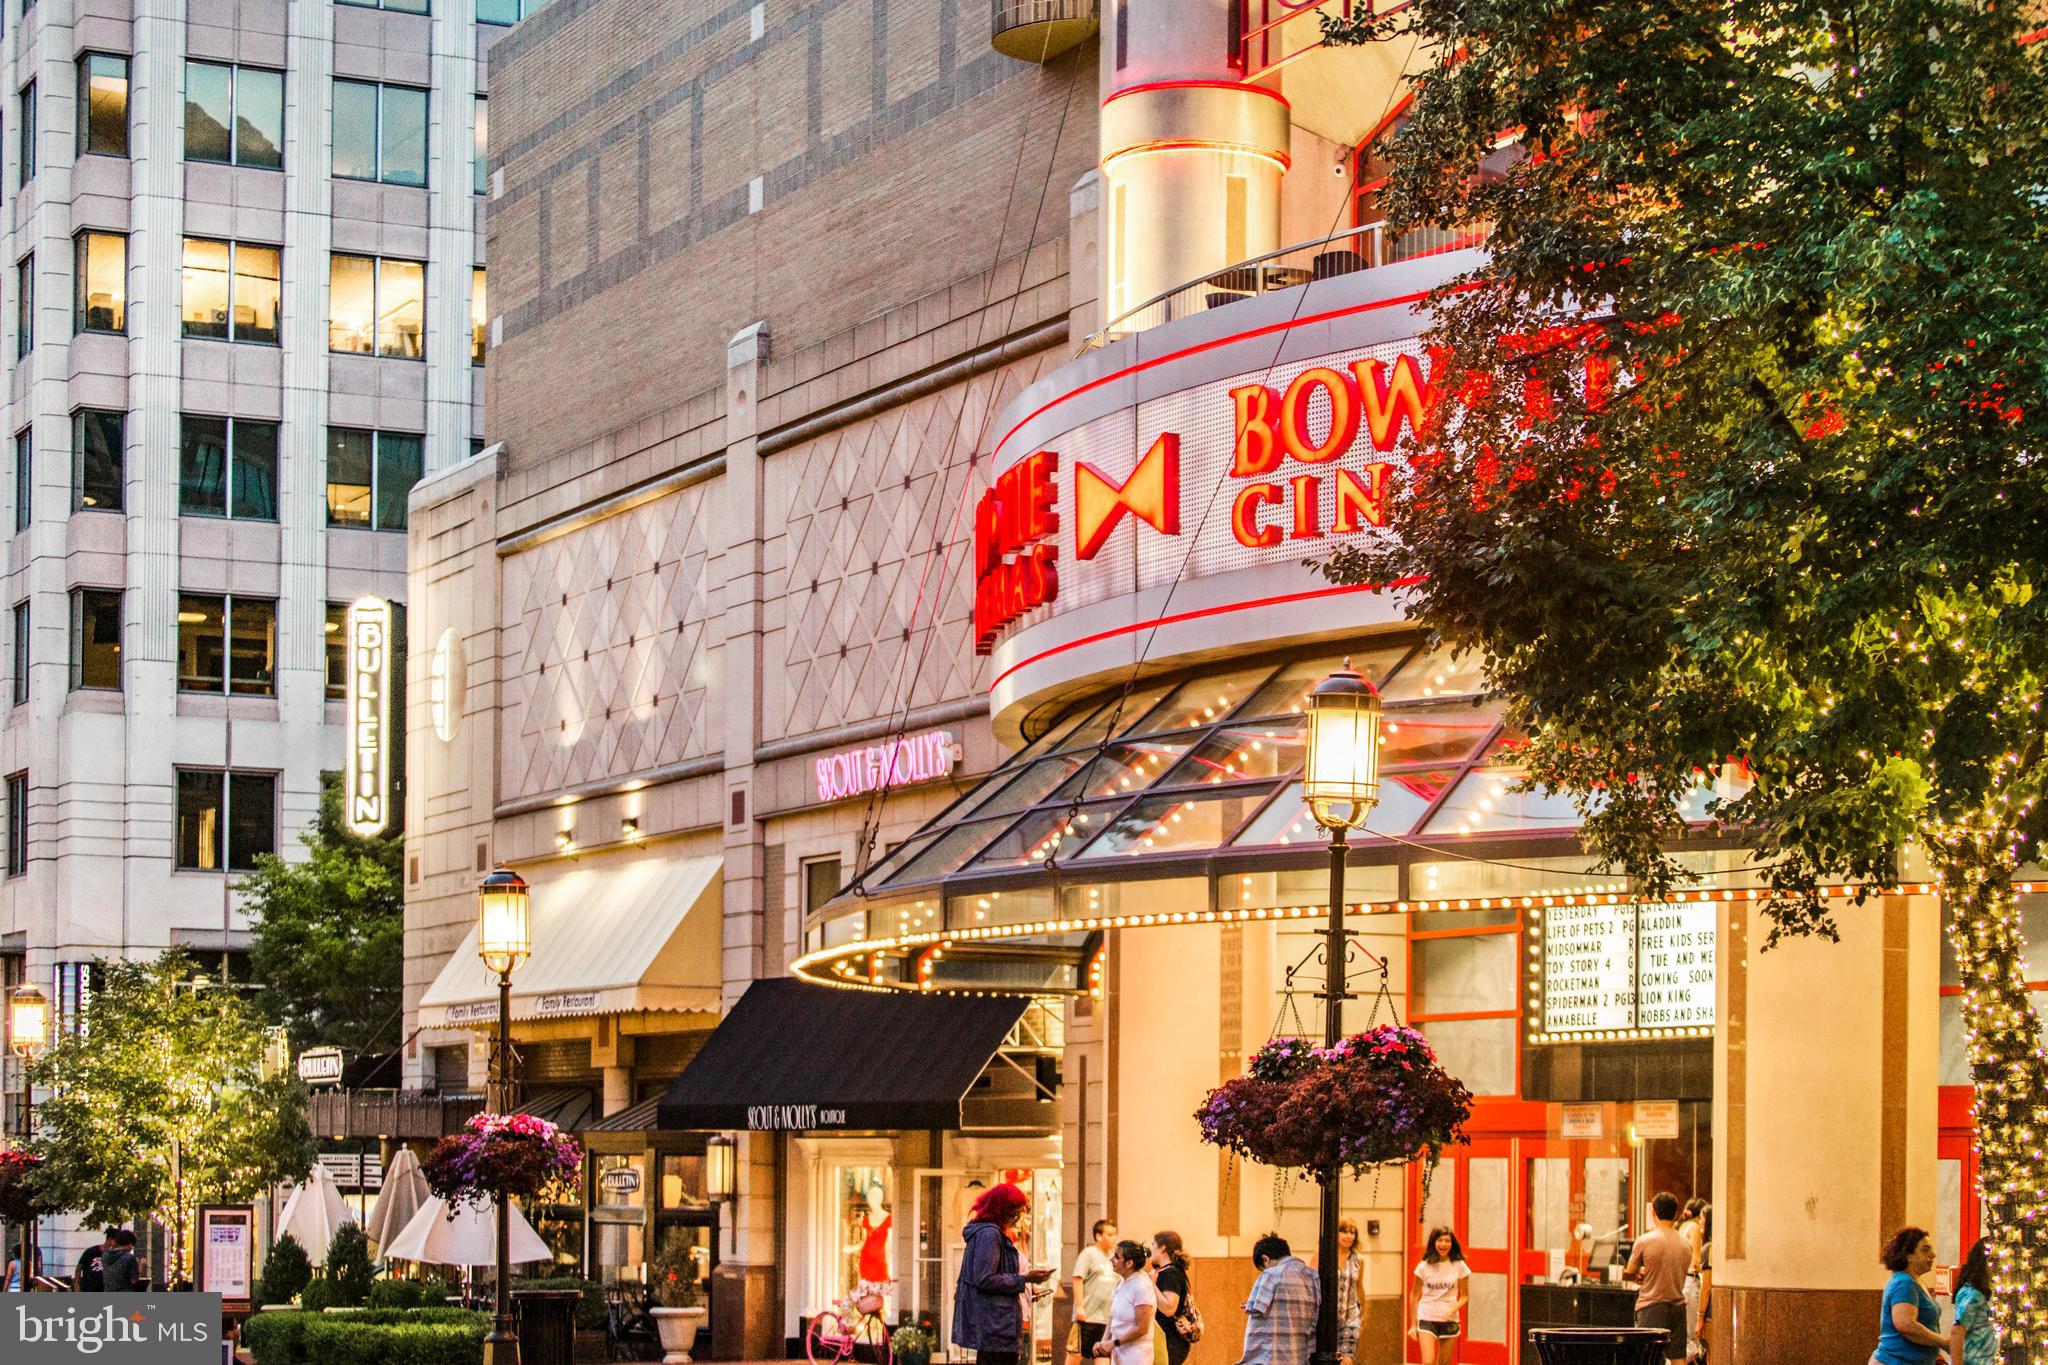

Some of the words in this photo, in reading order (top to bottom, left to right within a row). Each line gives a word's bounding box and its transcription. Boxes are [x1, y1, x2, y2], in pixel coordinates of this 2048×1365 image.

[1231, 462, 1394, 548] CIN
[358, 623, 383, 821] BULLETIN
[816, 750, 864, 801] SCOUT
[865, 746, 880, 790] &
[879, 731, 946, 788] MOLLY'S
[1547, 906, 1598, 921] YESTERDAY
[1547, 925, 1567, 939] LIFE
[1570, 923, 1580, 938] OF
[1583, 922, 1605, 936] PETS
[1608, 921, 1613, 934] 2
[1622, 919, 1635, 933] PG
[1640, 915, 1682, 931] ALADDIN
[1547, 941, 1602, 956] MIDSOMMAR
[1628, 938, 1634, 951] R
[1641, 935, 1664, 949] FREE
[1670, 933, 1692, 947] KIDS
[1697, 931, 1715, 945] SER
[1546, 961, 1565, 974] TOY
[1570, 958, 1599, 973] STORY
[1605, 958, 1611, 971] 4
[1627, 956, 1634, 969] G
[1650, 954, 1668, 967] TUE
[1676, 952, 1695, 966] AND
[1547, 976, 1600, 992] ROCKETMAN
[1628, 974, 1634, 987] R
[1641, 971, 1679, 987] COMING
[1689, 969, 1714, 984] SOON
[541, 996, 561, 1010] Family
[562, 994, 596, 1008] Restaurant
[1546, 994, 1598, 1010] SPIDERMAN
[1603, 993, 1608, 1007] 2
[1615, 992, 1635, 1006] PG13
[1640, 990, 1662, 1005] LION
[1668, 988, 1691, 1003] KING
[450, 1005, 469, 1019] Family
[1547, 1012, 1597, 1027] ANNABELLE
[1627, 1010, 1633, 1024] R
[1641, 1008, 1671, 1023] HOBBS
[1674, 1007, 1692, 1021] AND
[748, 1105, 773, 1130] SCOUT
[774, 1105, 780, 1129] &
[782, 1104, 818, 1129] MOLLY'S
[607, 1174, 636, 1187] BULLETIN
